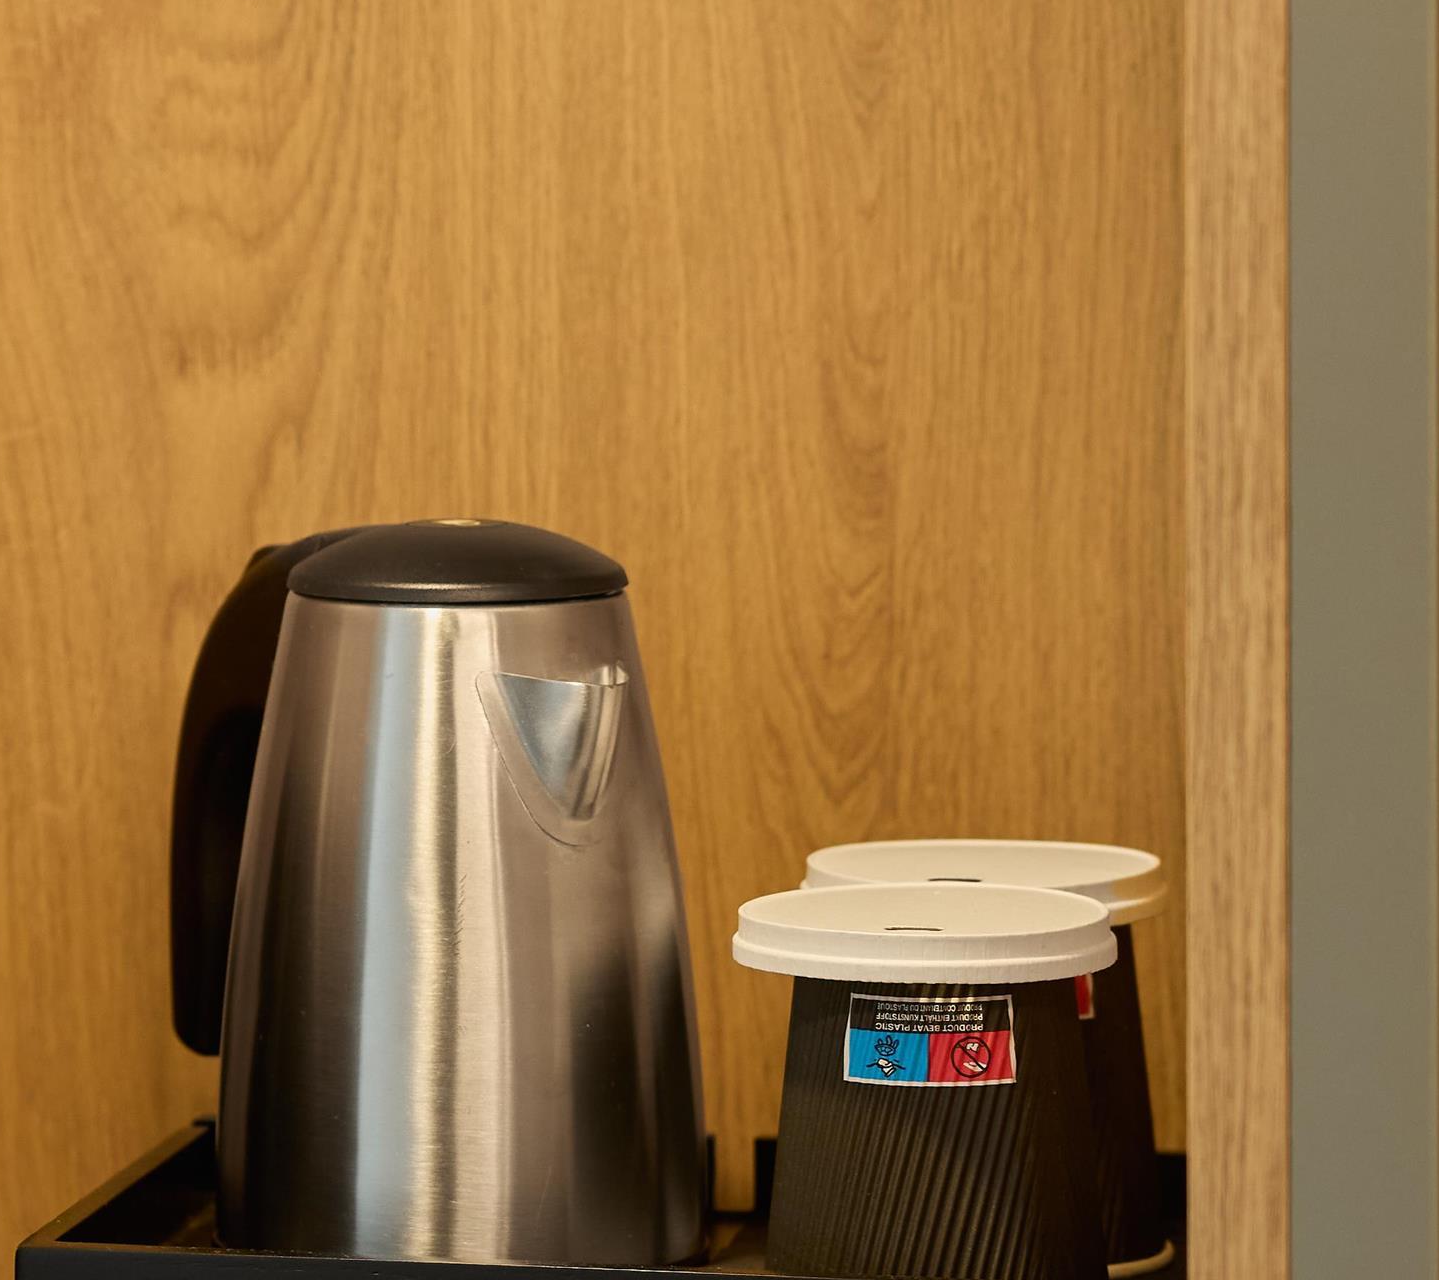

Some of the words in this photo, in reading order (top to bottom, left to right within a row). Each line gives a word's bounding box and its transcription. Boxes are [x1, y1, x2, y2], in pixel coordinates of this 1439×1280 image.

[875, 1020, 910, 1032] PLASTIC
[913, 1022, 940, 1032] BEVAT
[943, 1022, 983, 1032] PRODUCT
